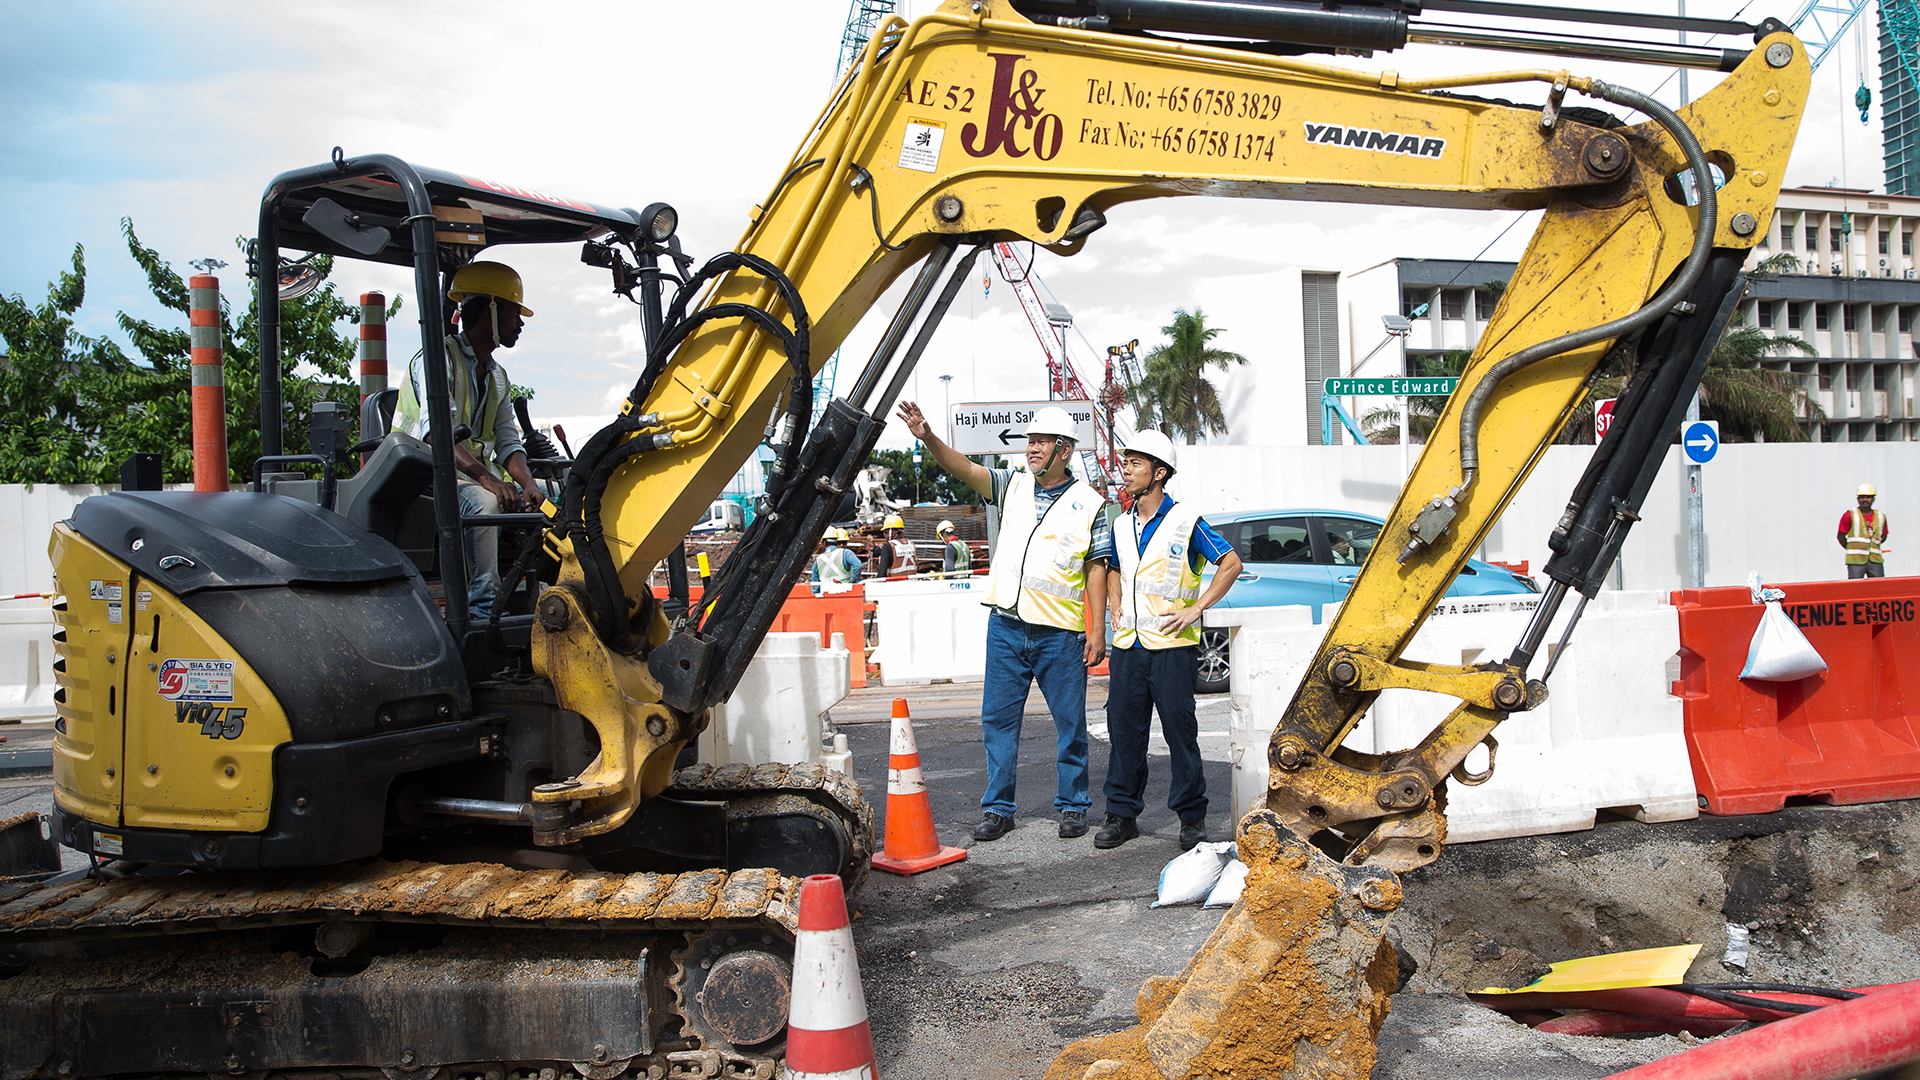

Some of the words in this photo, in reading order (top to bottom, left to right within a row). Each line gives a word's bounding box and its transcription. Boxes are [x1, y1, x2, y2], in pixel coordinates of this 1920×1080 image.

[894, 78, 938, 107] AE
[943, 85, 975, 113] 52
[1087, 78, 1115, 106] Tel.
[1120, 81, 1151, 110] No:
[1157, 86, 1190, 112] +65
[1193, 88, 1235, 117] 6758
[1238, 92, 1282, 121] 3829
[1078, 118, 1112, 146] Fax
[1114, 121, 1146, 149] No:
[1151, 126, 1184, 153] +65
[1187, 128, 1229, 157] 6758
[1233, 132, 1276, 162] 1374
[1305, 123, 1445, 158] YANMAR
[1333, 379, 1385, 394] Prince
[1391, 379, 1449, 394] Edward
[955, 412, 978, 428] Haji
[982, 411, 1011, 425] Muhd
[1015, 411, 1035, 424] Sall
[1070, 412, 1091, 425] que
[1597, 413, 1615, 432] ST
[1431, 605, 1446, 616] OT
[1449, 605, 1458, 615] A
[1462, 602, 1506, 614] SAFETY
[1852, 599, 1916, 625] ENGRG
[167, 660, 176, 668] BY
[1601, 970, 1639, 980] DANGER
